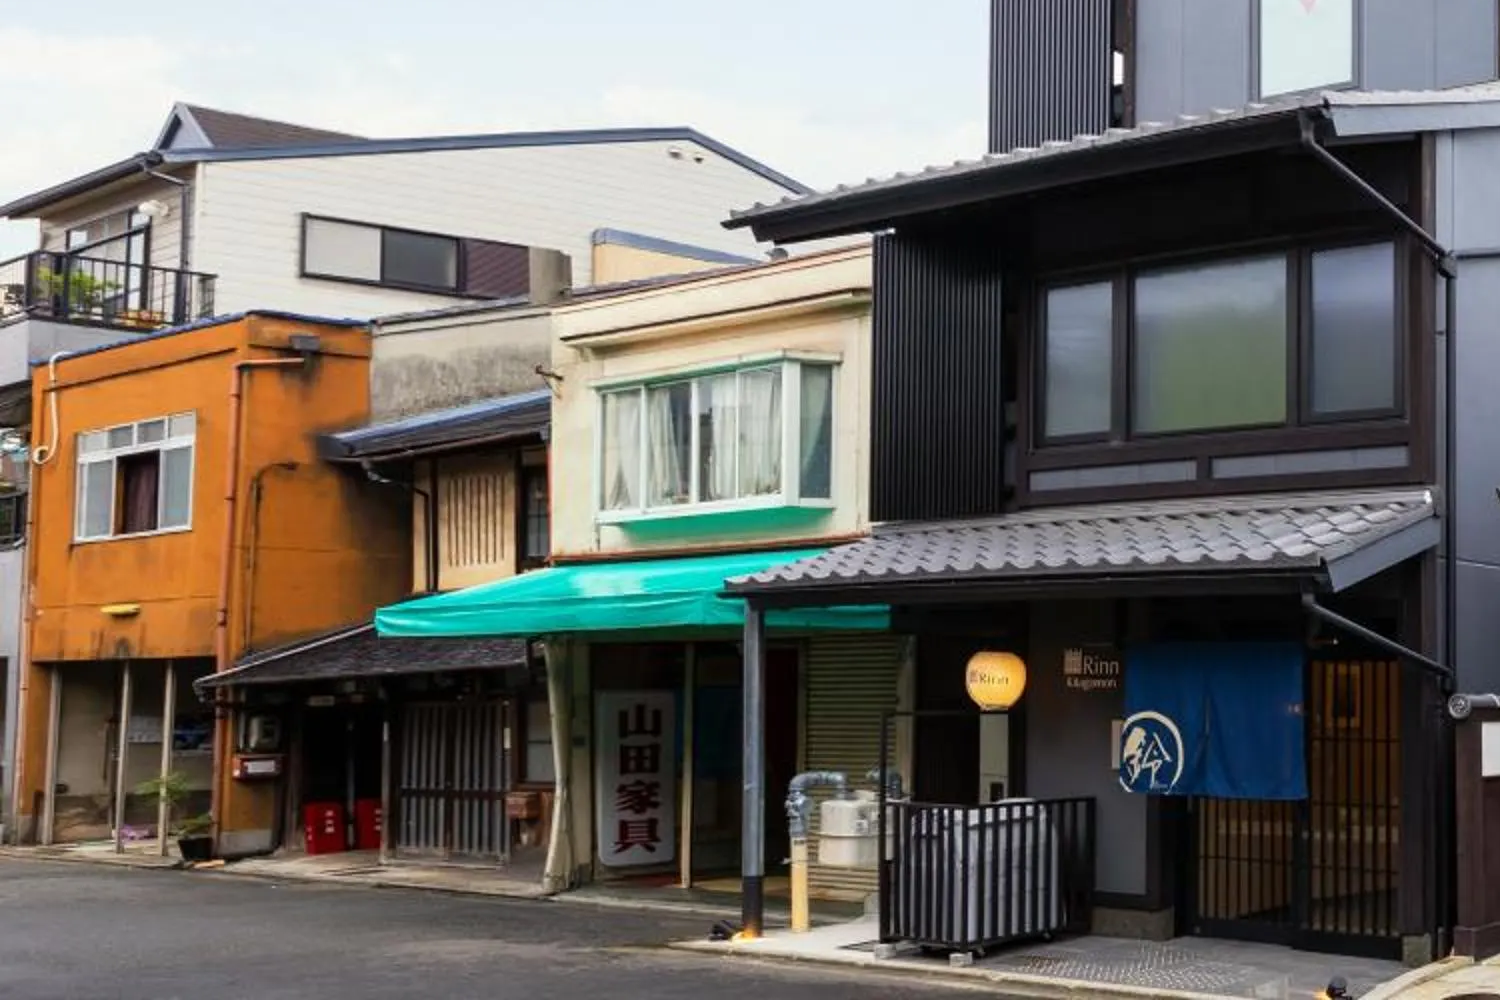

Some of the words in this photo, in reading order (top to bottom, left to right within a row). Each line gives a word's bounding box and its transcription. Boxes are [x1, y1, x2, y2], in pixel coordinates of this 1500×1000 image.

[1084, 656, 1119, 675] Rinn
[613, 704, 663, 854] 山田家具
